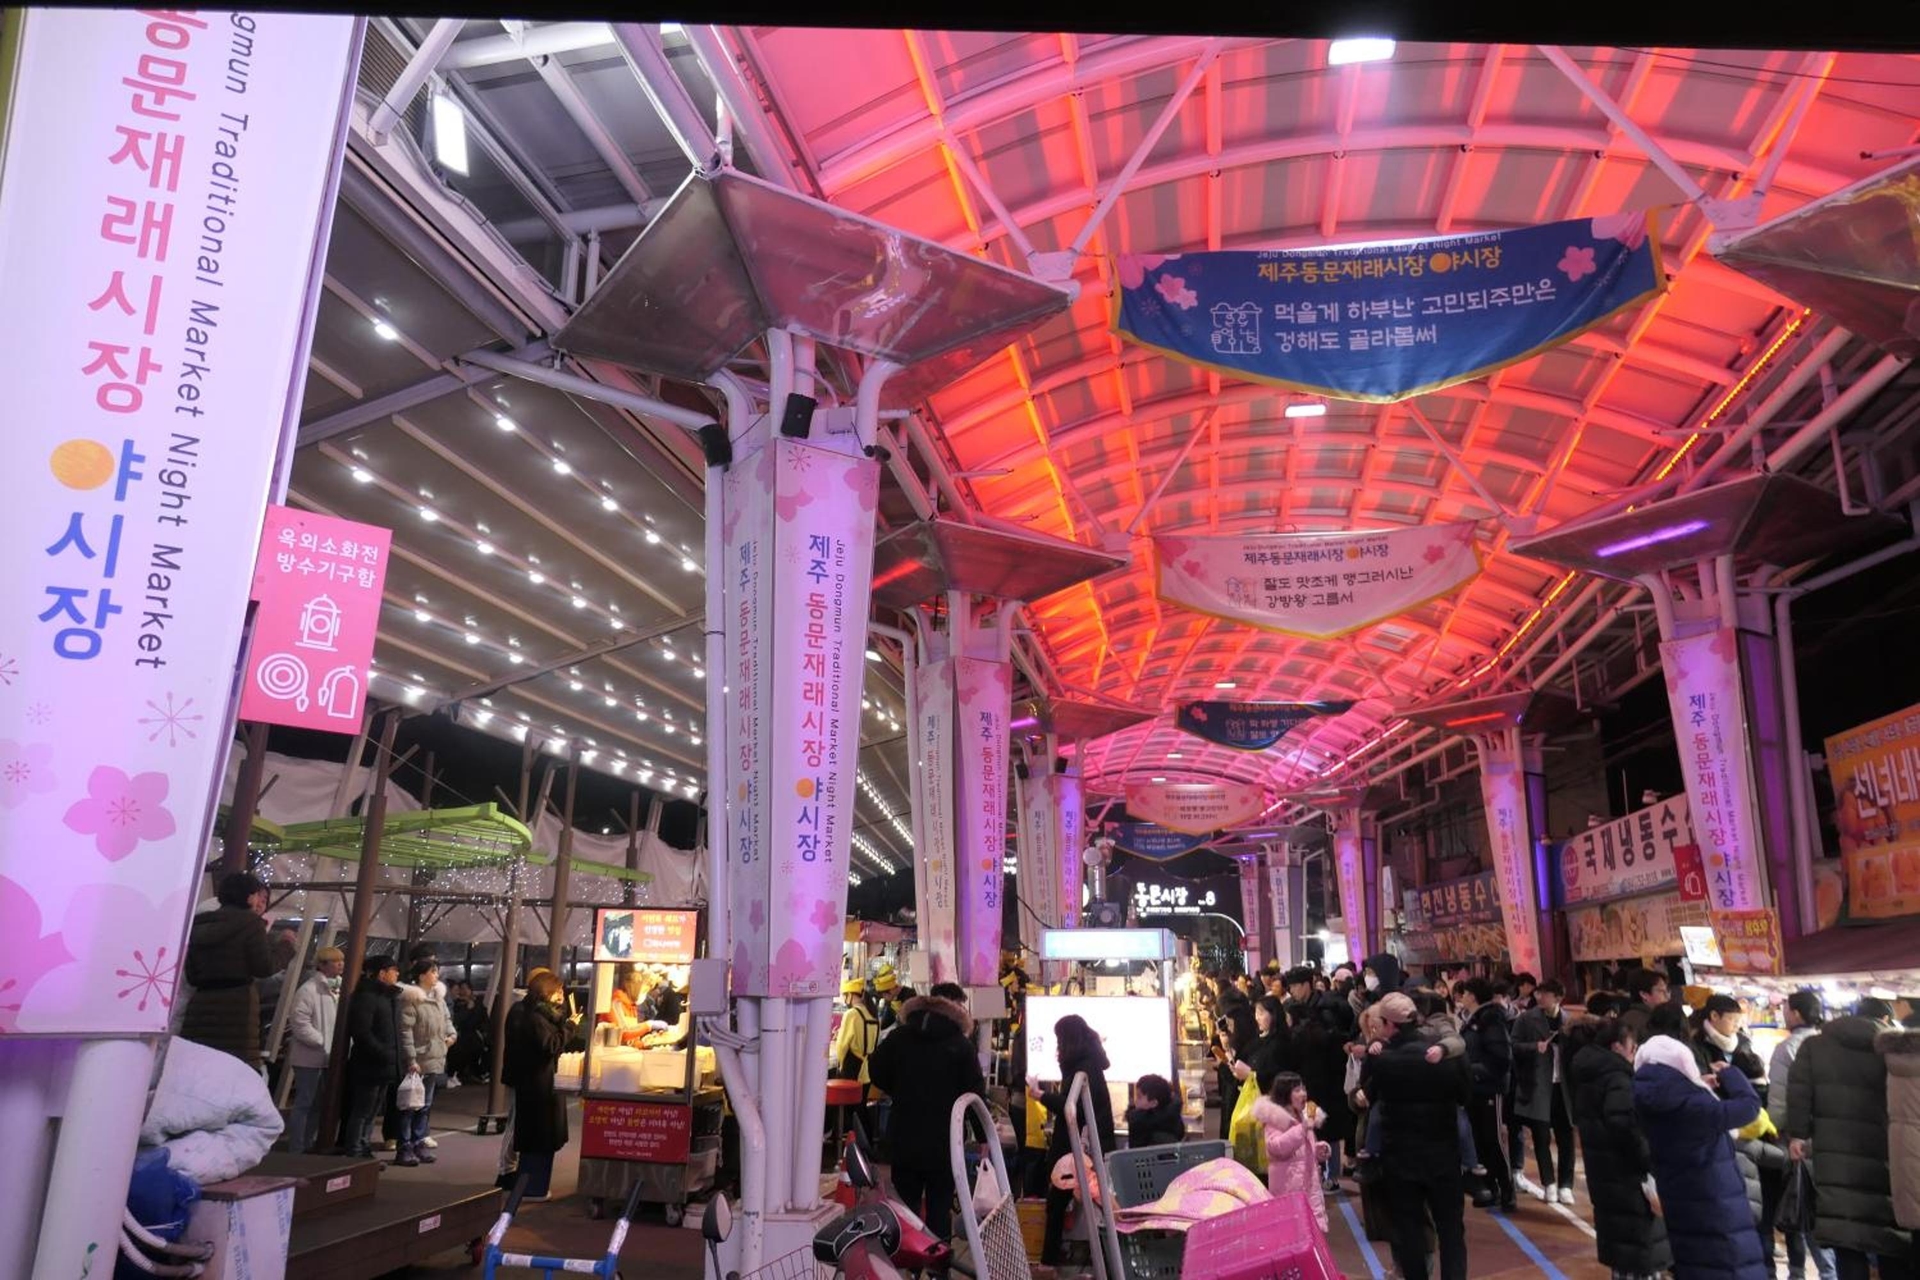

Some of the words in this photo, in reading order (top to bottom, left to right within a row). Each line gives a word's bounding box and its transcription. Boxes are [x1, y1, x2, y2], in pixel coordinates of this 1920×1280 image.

[193, 112, 249, 287] Traditional
[1433, 236, 1461, 250] Night
[1465, 232, 1501, 246] Market
[1257, 255, 1426, 284] 제주동문재래시장
[1275, 301, 1339, 324] 먹을게
[1348, 297, 1415, 321] 하부난
[1422, 278, 1556, 315] 고민되주만은
[174, 300, 220, 417] Market
[157, 433, 200, 525] Night
[38, 437, 145, 662] 야시장
[276, 552, 376, 589] 방수기구함
[278, 528, 379, 565] 옥외소화전
[739, 541, 751, 592] 제주
[806, 534, 831, 584] 제주
[836, 539, 846, 567] Jeju
[1244, 548, 1344, 565] 제주동문재래시장
[134, 543, 182, 670] Market
[833, 574, 845, 632] Dongmun
[739, 600, 752, 772] 동문재래시장
[802, 592, 829, 768] 동문재래시장
[831, 640, 843, 713] Traditional
[979, 711, 993, 743] 제주
[1689, 693, 1706, 727] 제주
[828, 719, 840, 765] Market
[826, 771, 838, 808] Night
[981, 746, 996, 852] 동문재래시장
[1692, 732, 1726, 846] 동문재래시장
[796, 777, 824, 863] 야시장
[824, 814, 836, 863] Market
